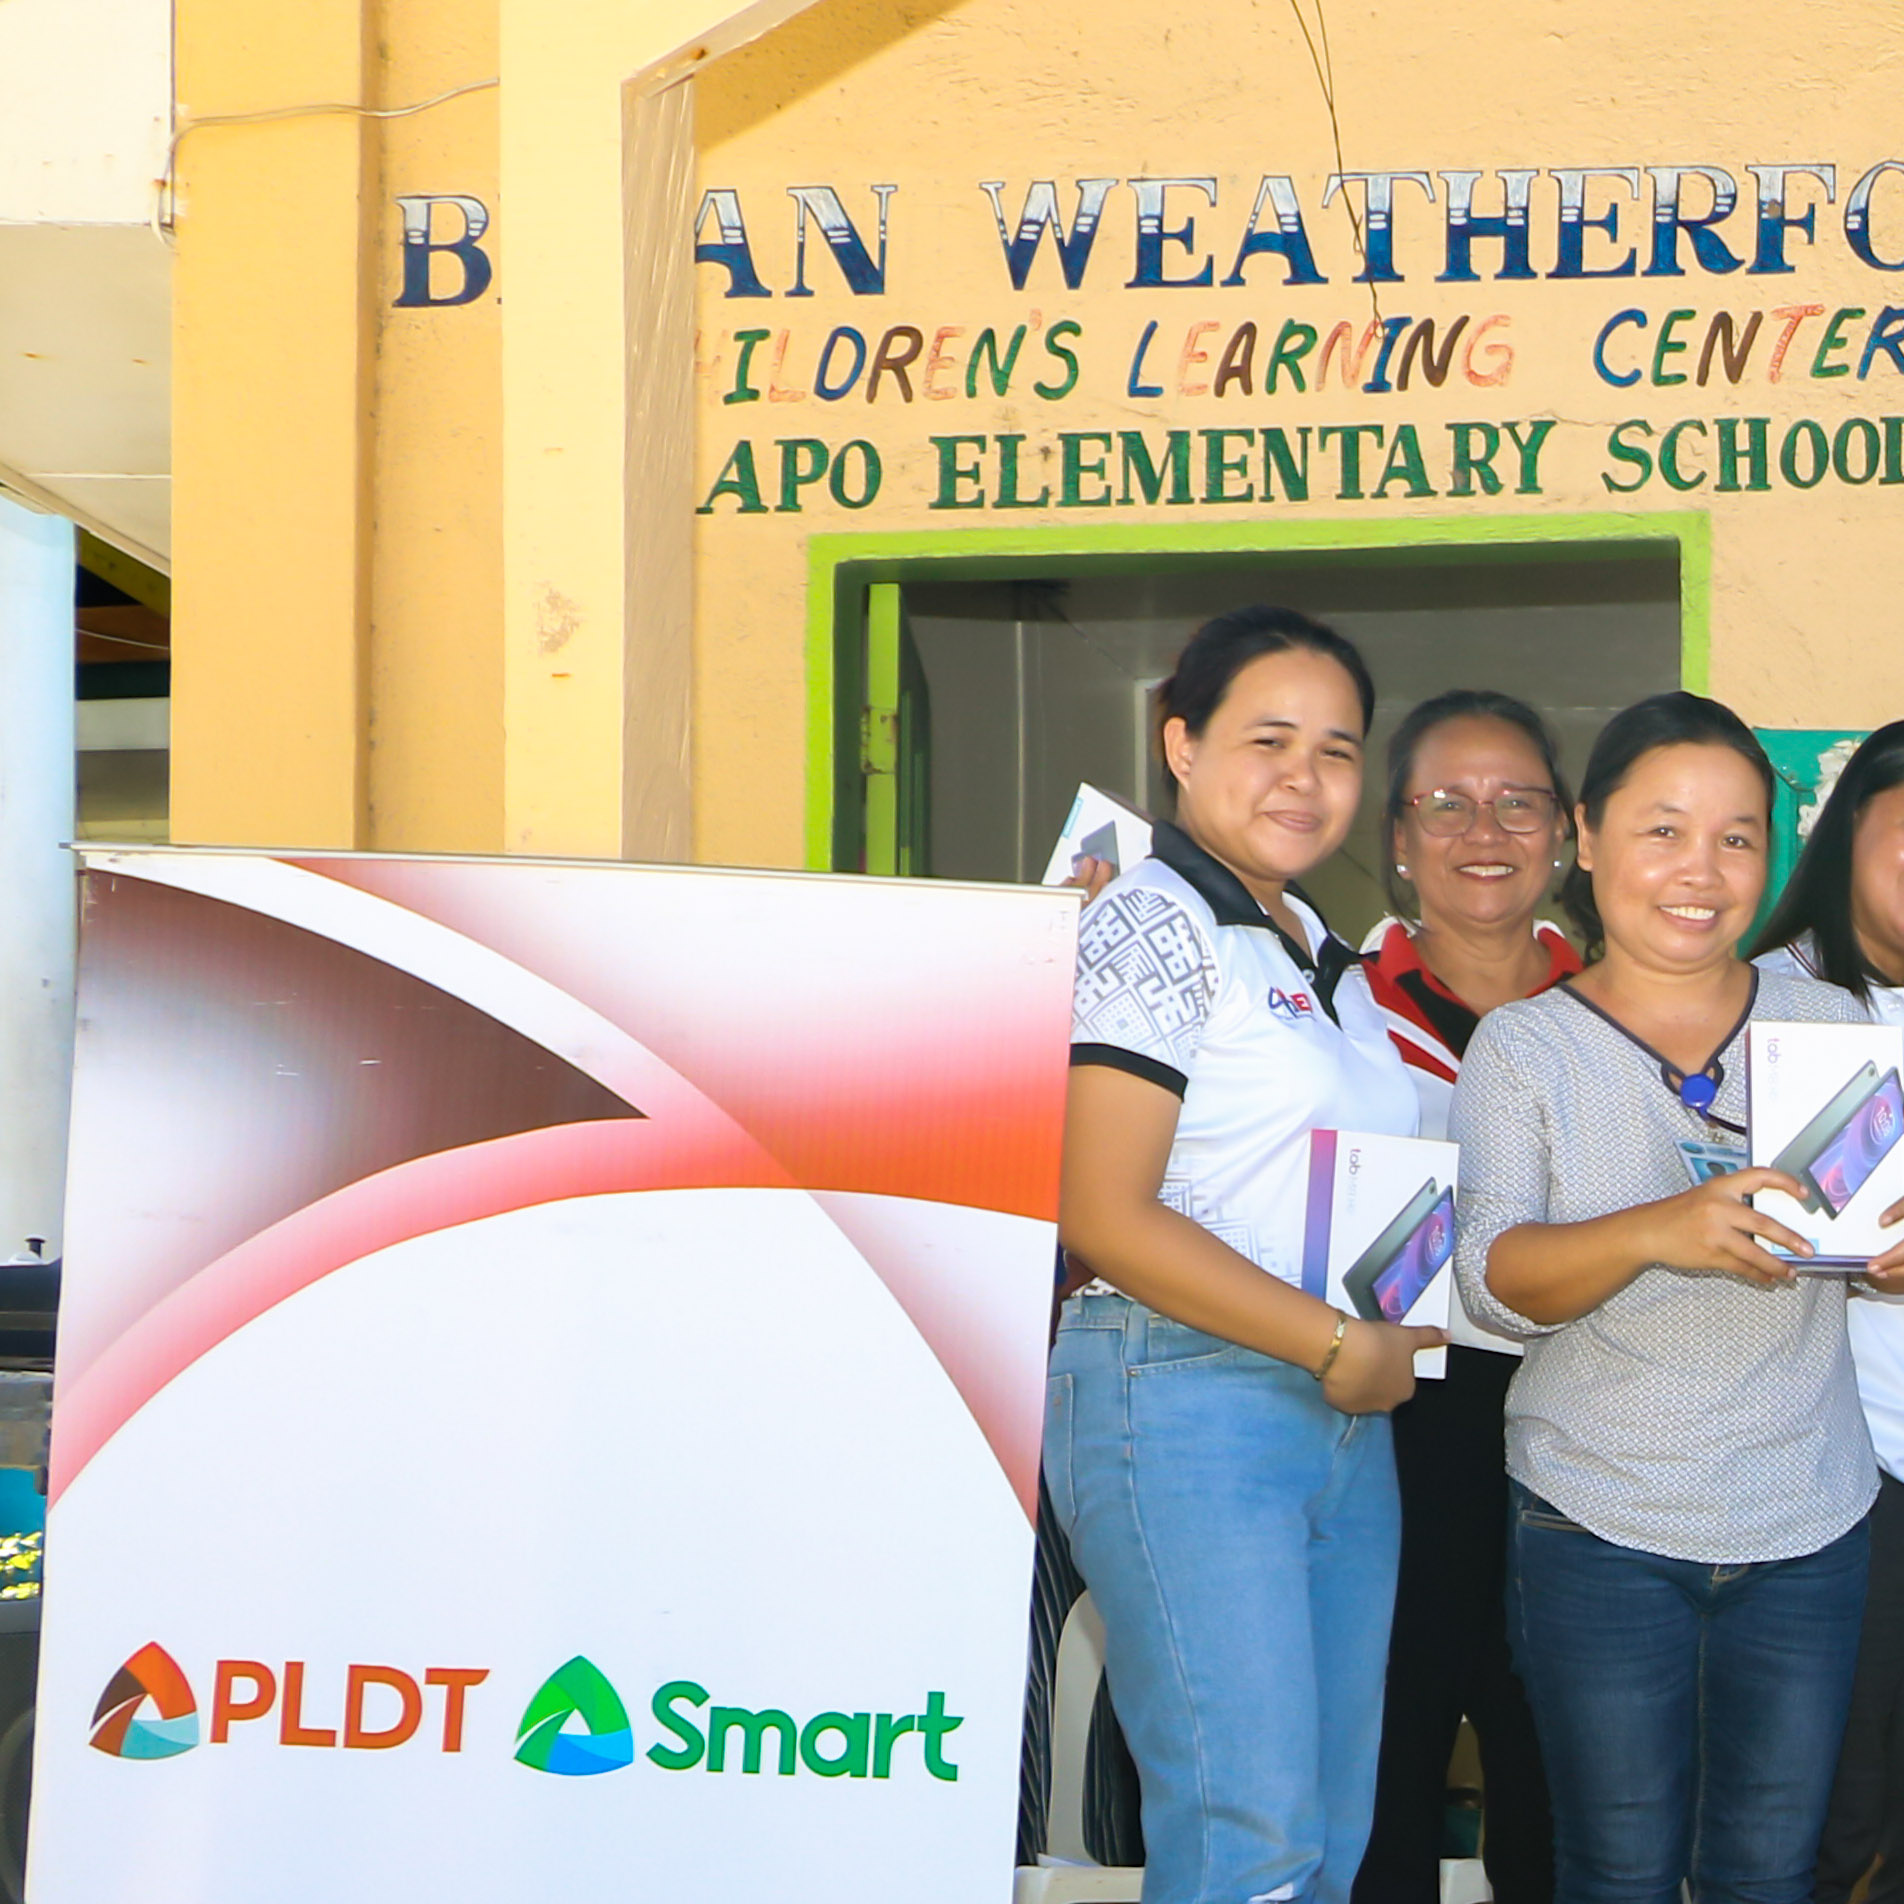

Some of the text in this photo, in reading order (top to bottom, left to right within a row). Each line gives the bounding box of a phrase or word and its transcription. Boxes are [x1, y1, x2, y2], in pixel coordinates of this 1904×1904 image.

[695, 309, 1083, 406] HILDREN'S
[1128, 314, 1513, 398] LEARNING
[695, 438, 883, 515] APO
[928, 418, 1557, 511] ELEMENTARY
[1767, 1037, 1780, 1064] tab
[1348, 1148, 1361, 1175] tab
[209, 1659, 964, 1782] PLDT Smart
